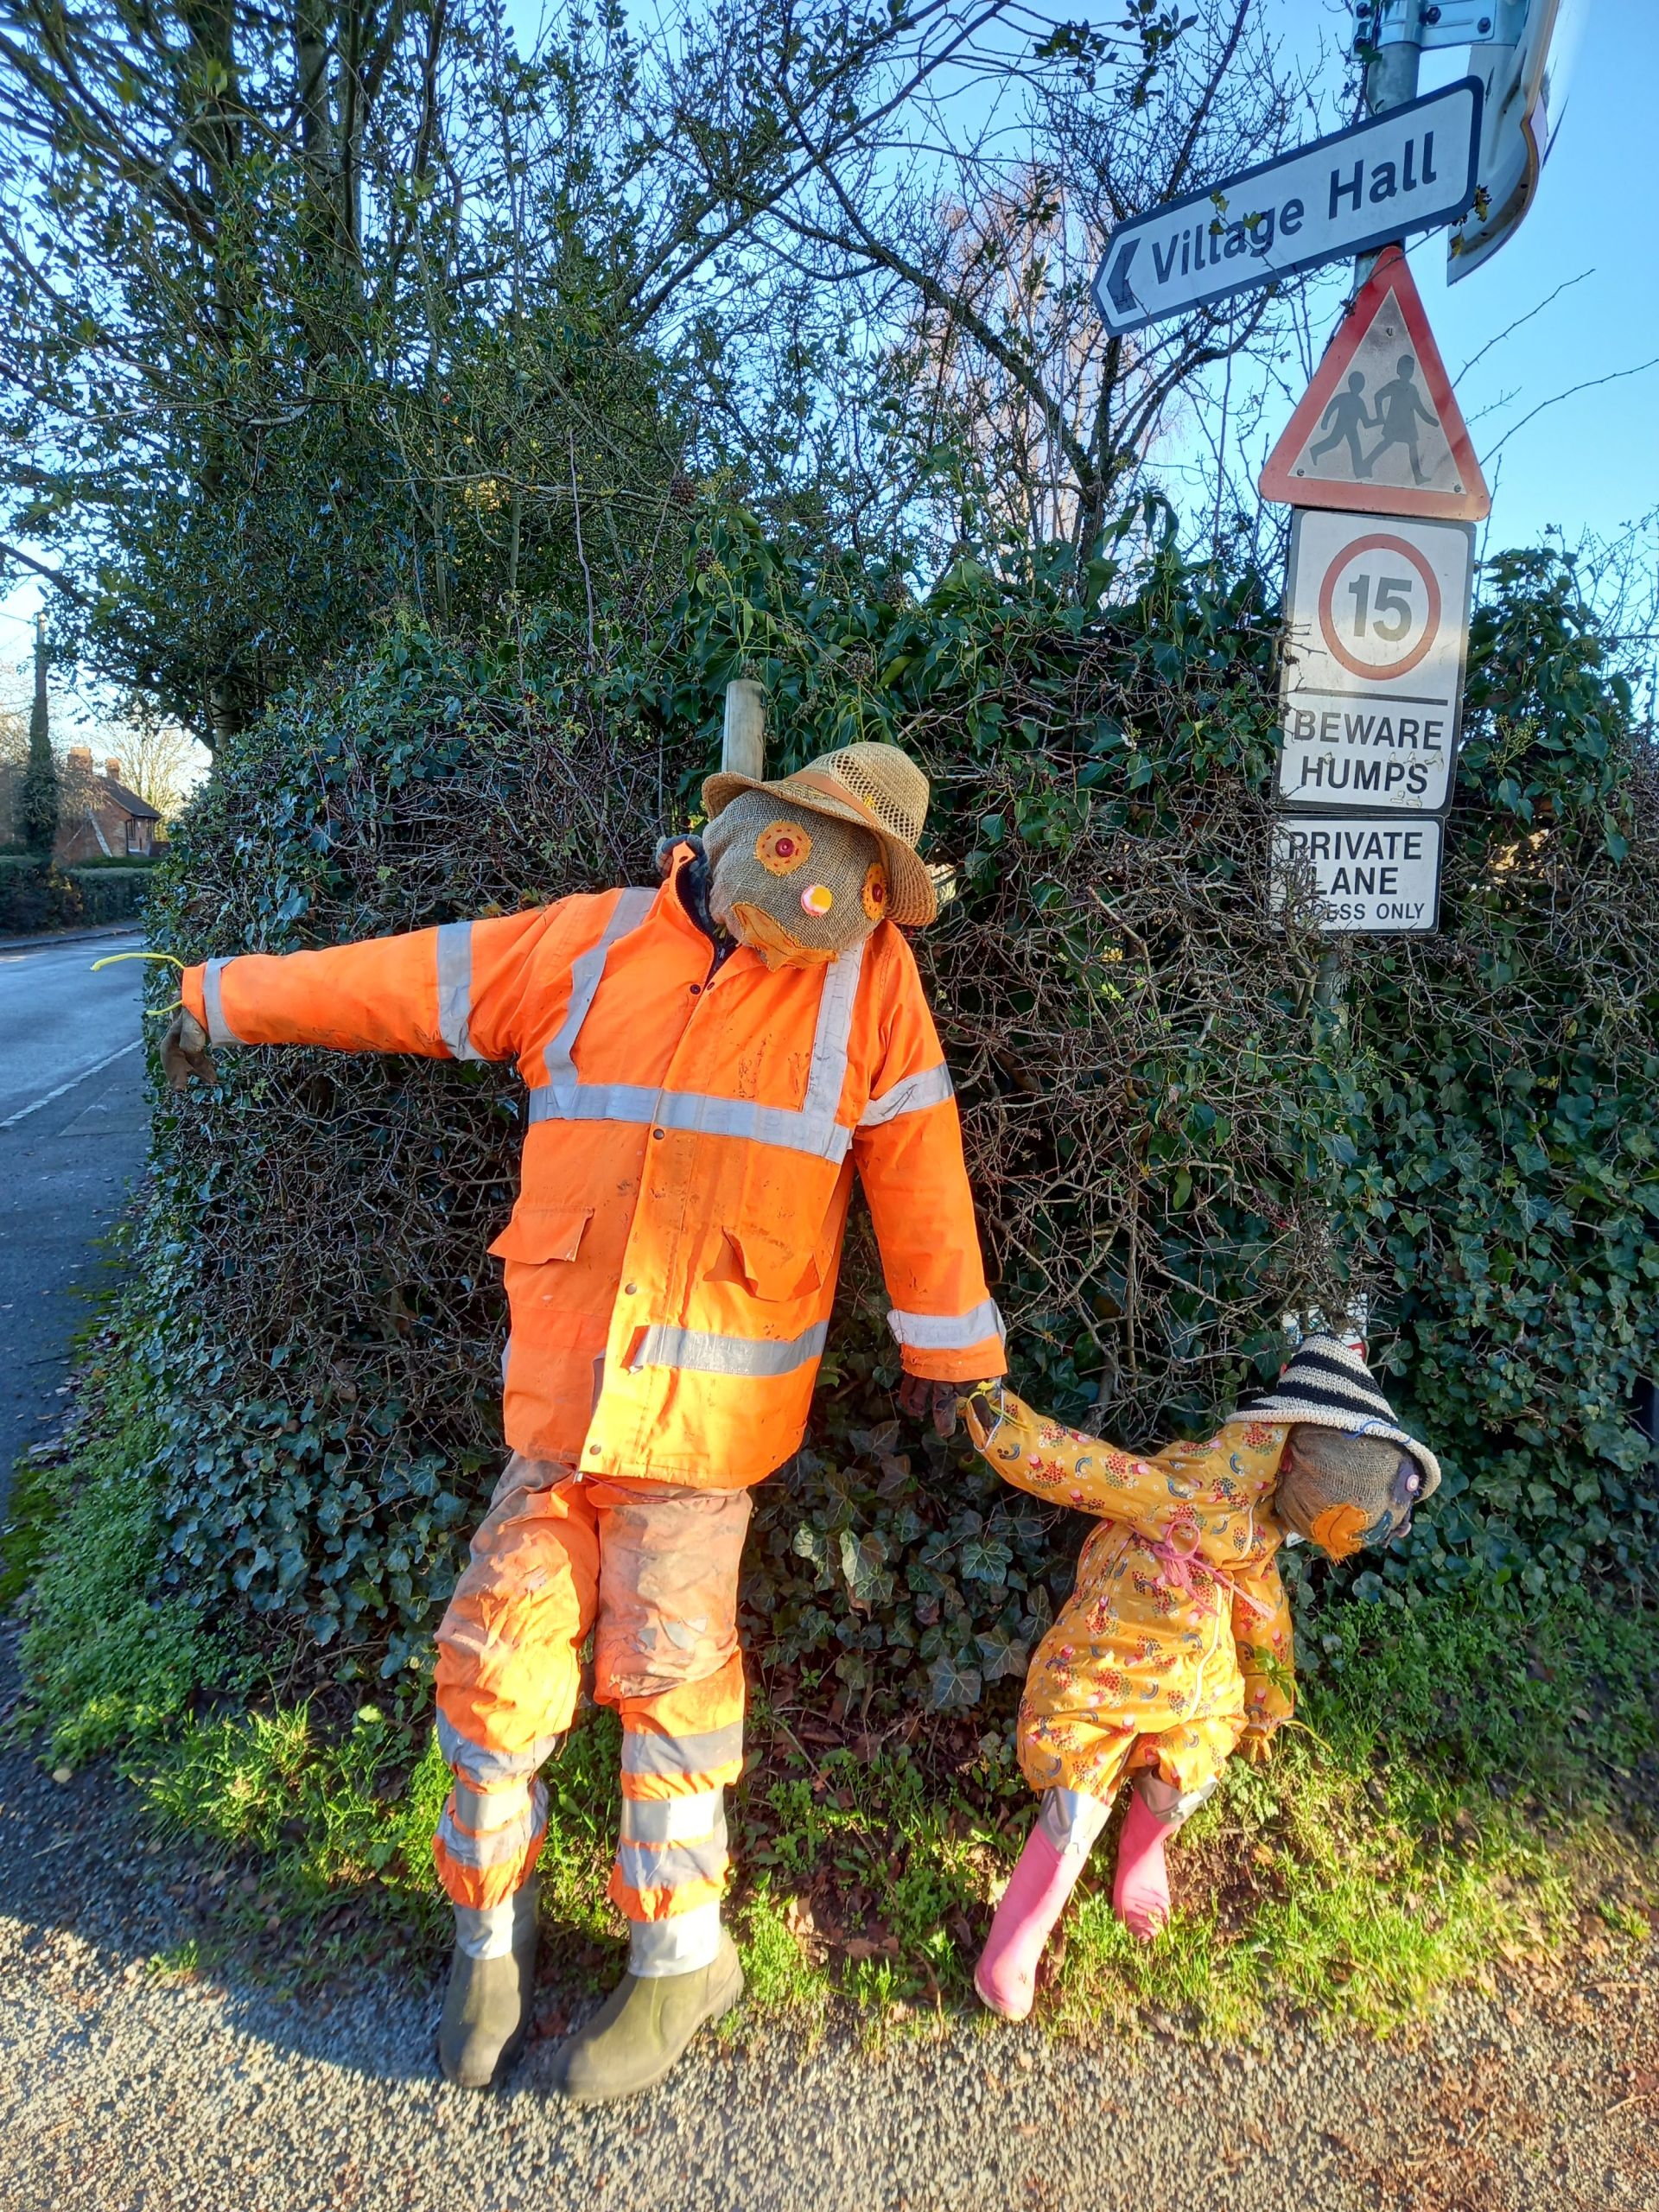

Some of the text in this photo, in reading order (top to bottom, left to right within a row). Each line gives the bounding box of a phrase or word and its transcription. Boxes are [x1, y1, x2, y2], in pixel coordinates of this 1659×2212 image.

[1152, 130, 1437, 284] Village Hall
[1348, 574, 1412, 642] 15
[1294, 709, 1444, 751] BEWARE
[1300, 755, 1429, 795] HUMPS
[1288, 831, 1423, 861] PRIVATE
[1310, 866, 1399, 895] LANE
[1376, 902, 1425, 920] ONLY
